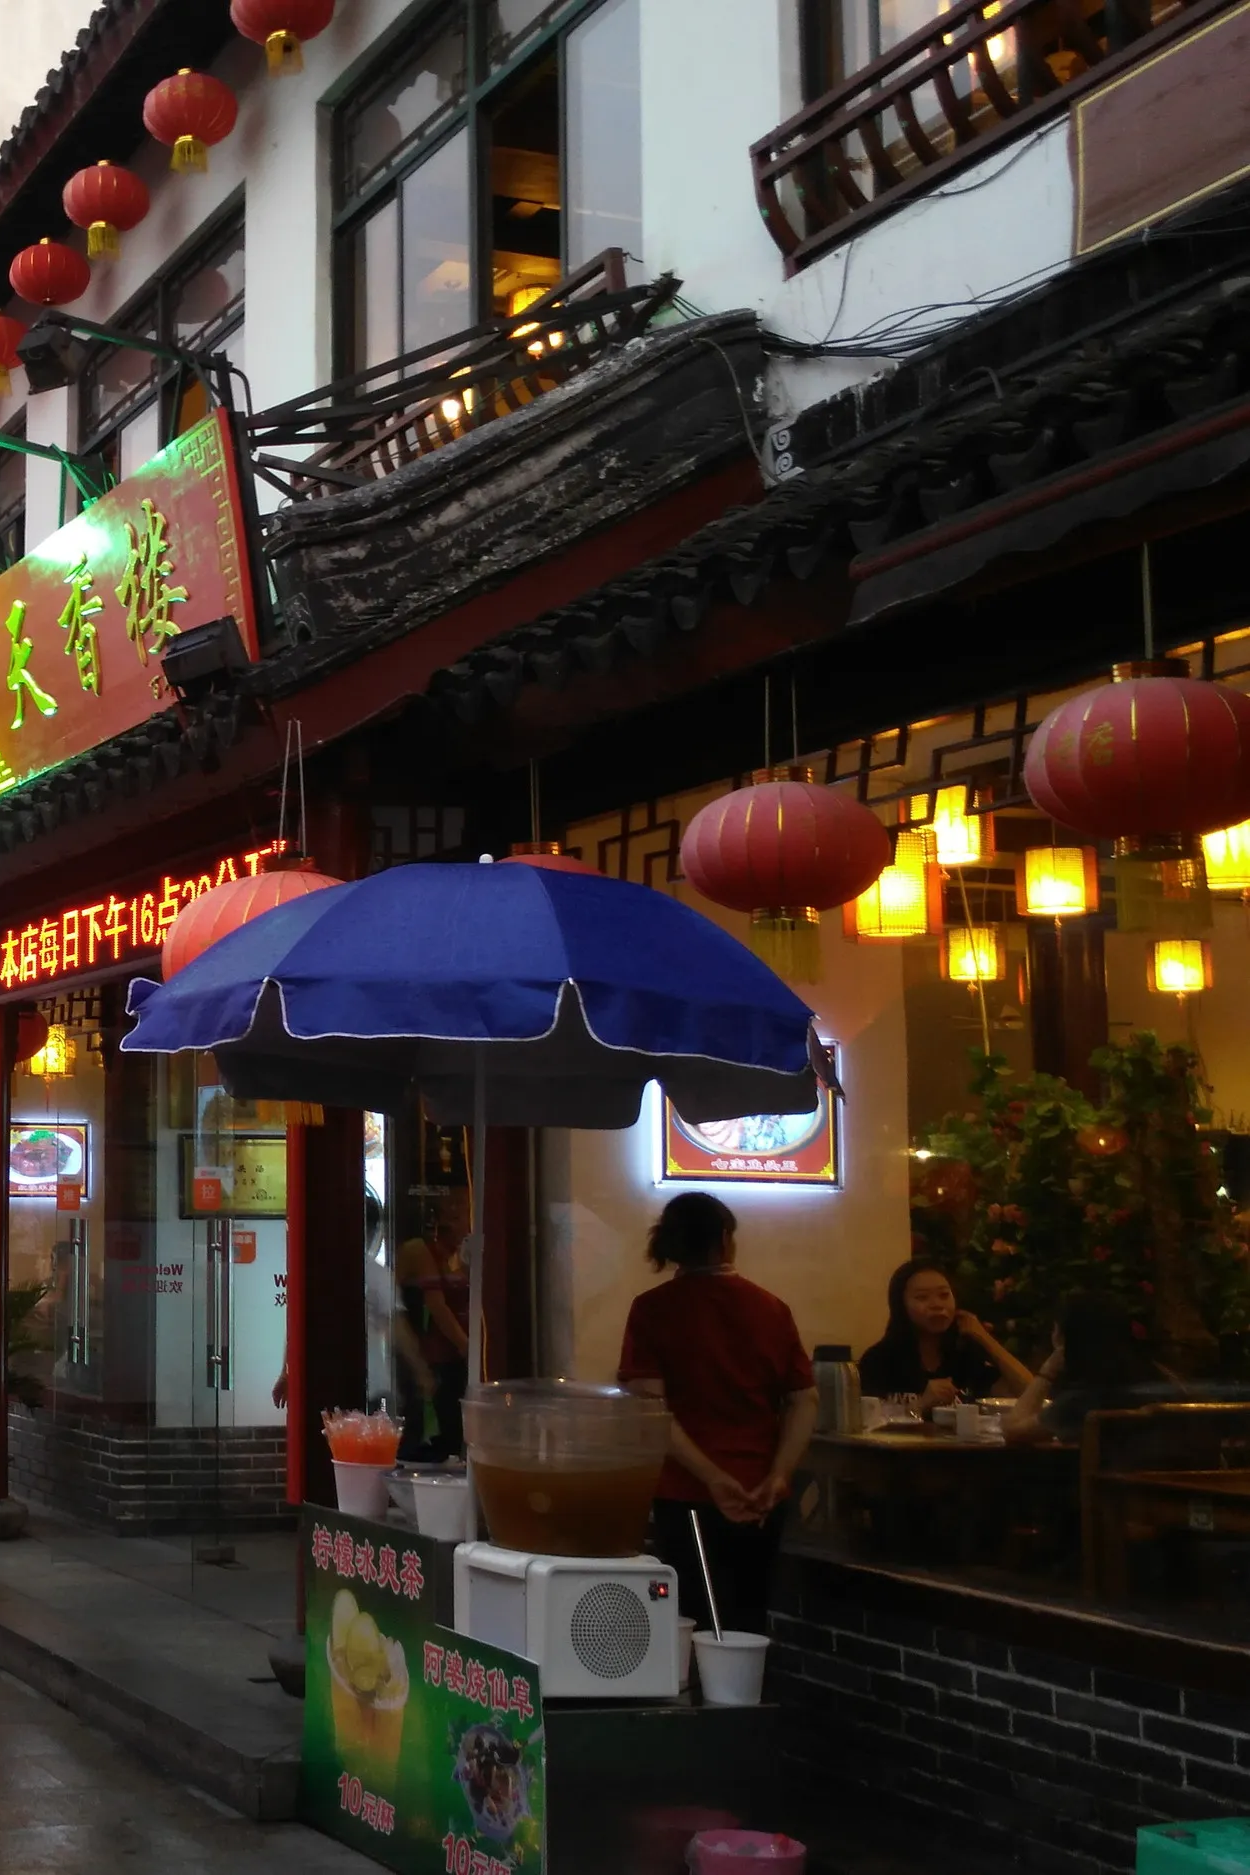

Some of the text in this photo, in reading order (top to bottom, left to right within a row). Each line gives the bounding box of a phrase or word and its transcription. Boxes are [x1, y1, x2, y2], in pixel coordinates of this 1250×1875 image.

[202, 1184, 216, 1199] 拉
[312, 1523, 424, 1600] 柠檬冰爽茶
[422, 1640, 535, 1721] 阿婆烧仙草
